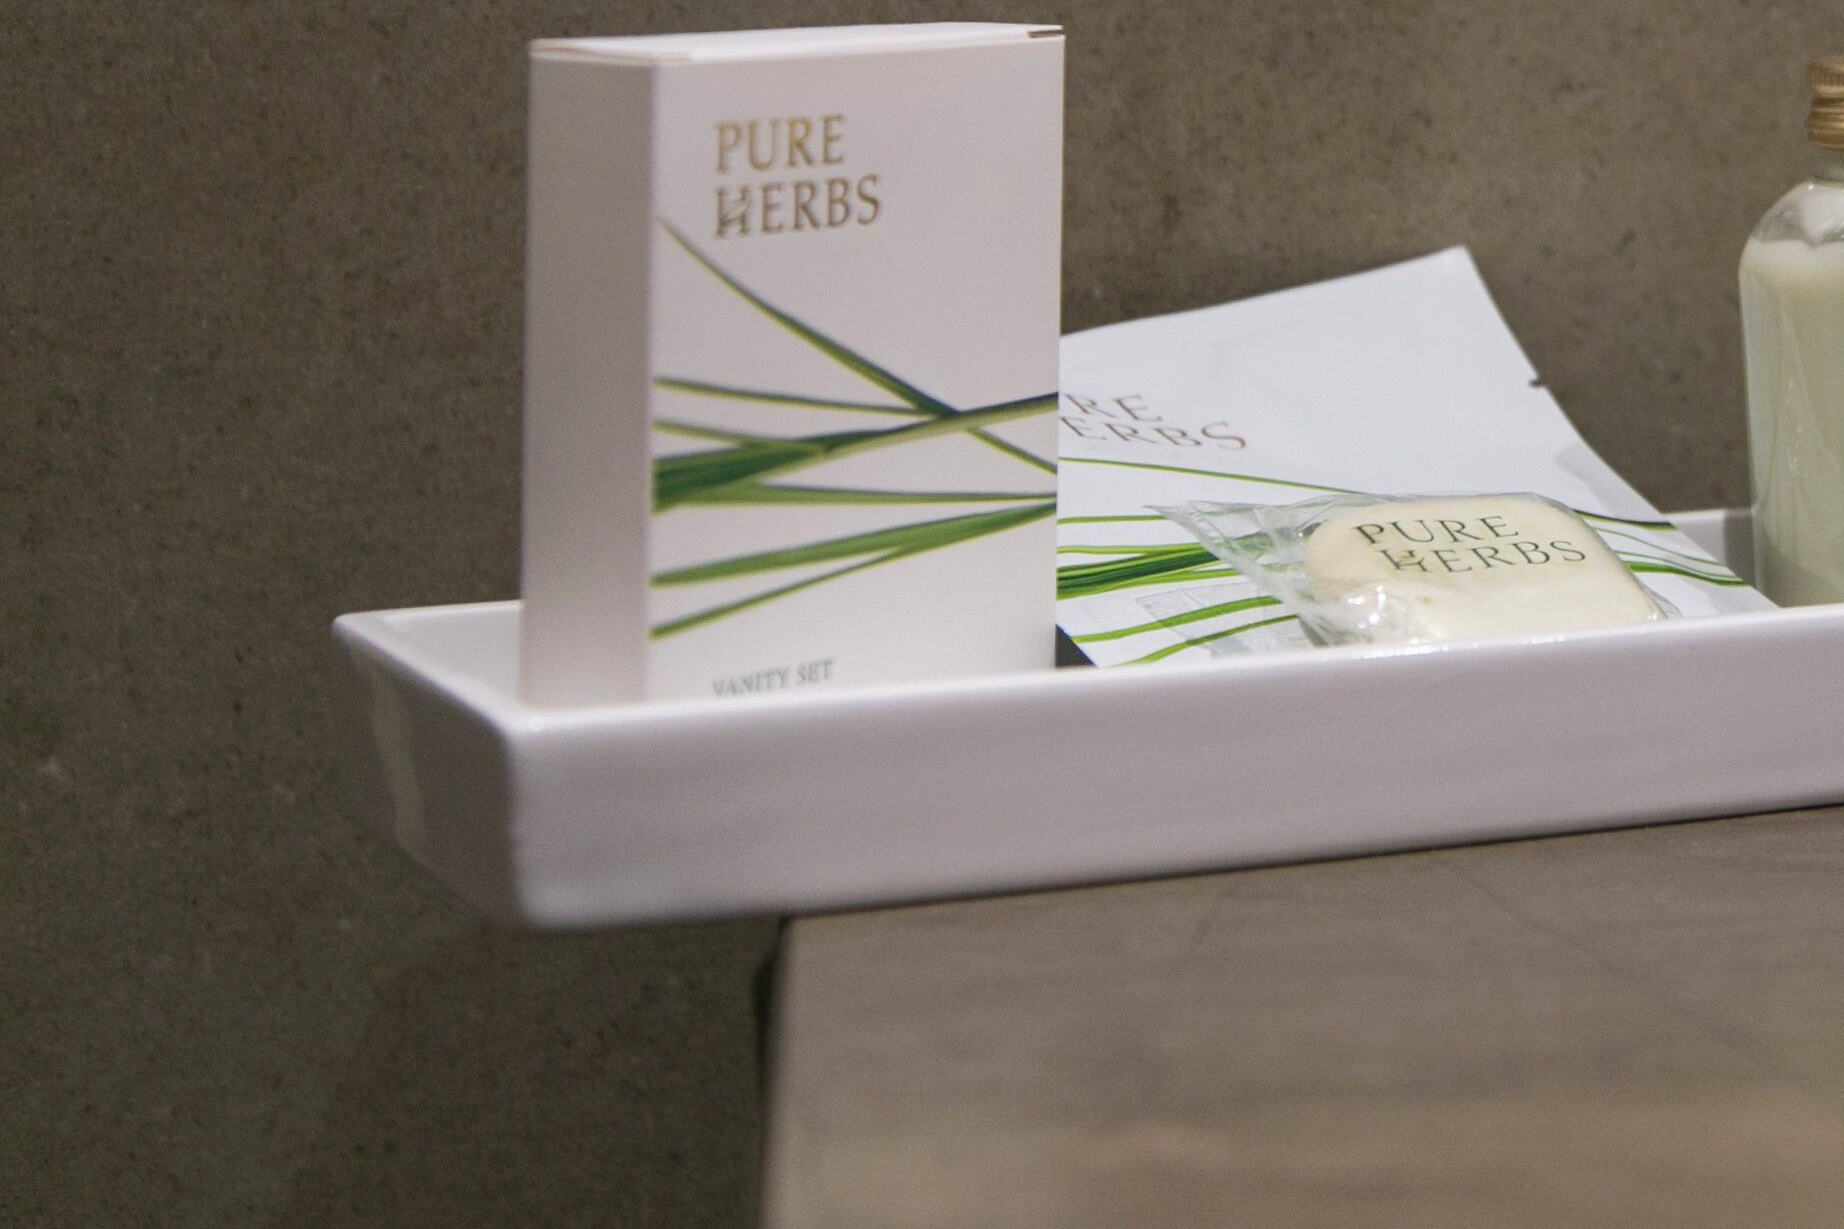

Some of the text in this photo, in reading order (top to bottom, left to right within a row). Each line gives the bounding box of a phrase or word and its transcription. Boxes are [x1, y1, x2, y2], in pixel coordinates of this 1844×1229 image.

[714, 114, 846, 174] PURE
[714, 174, 880, 237] HERBS
[1062, 394, 1163, 421] RE
[1059, 417, 1246, 450] ERBS
[1351, 516, 1519, 545] PURE
[1376, 541, 1587, 573] HERBS
[711, 657, 833, 698] VANITY SET
